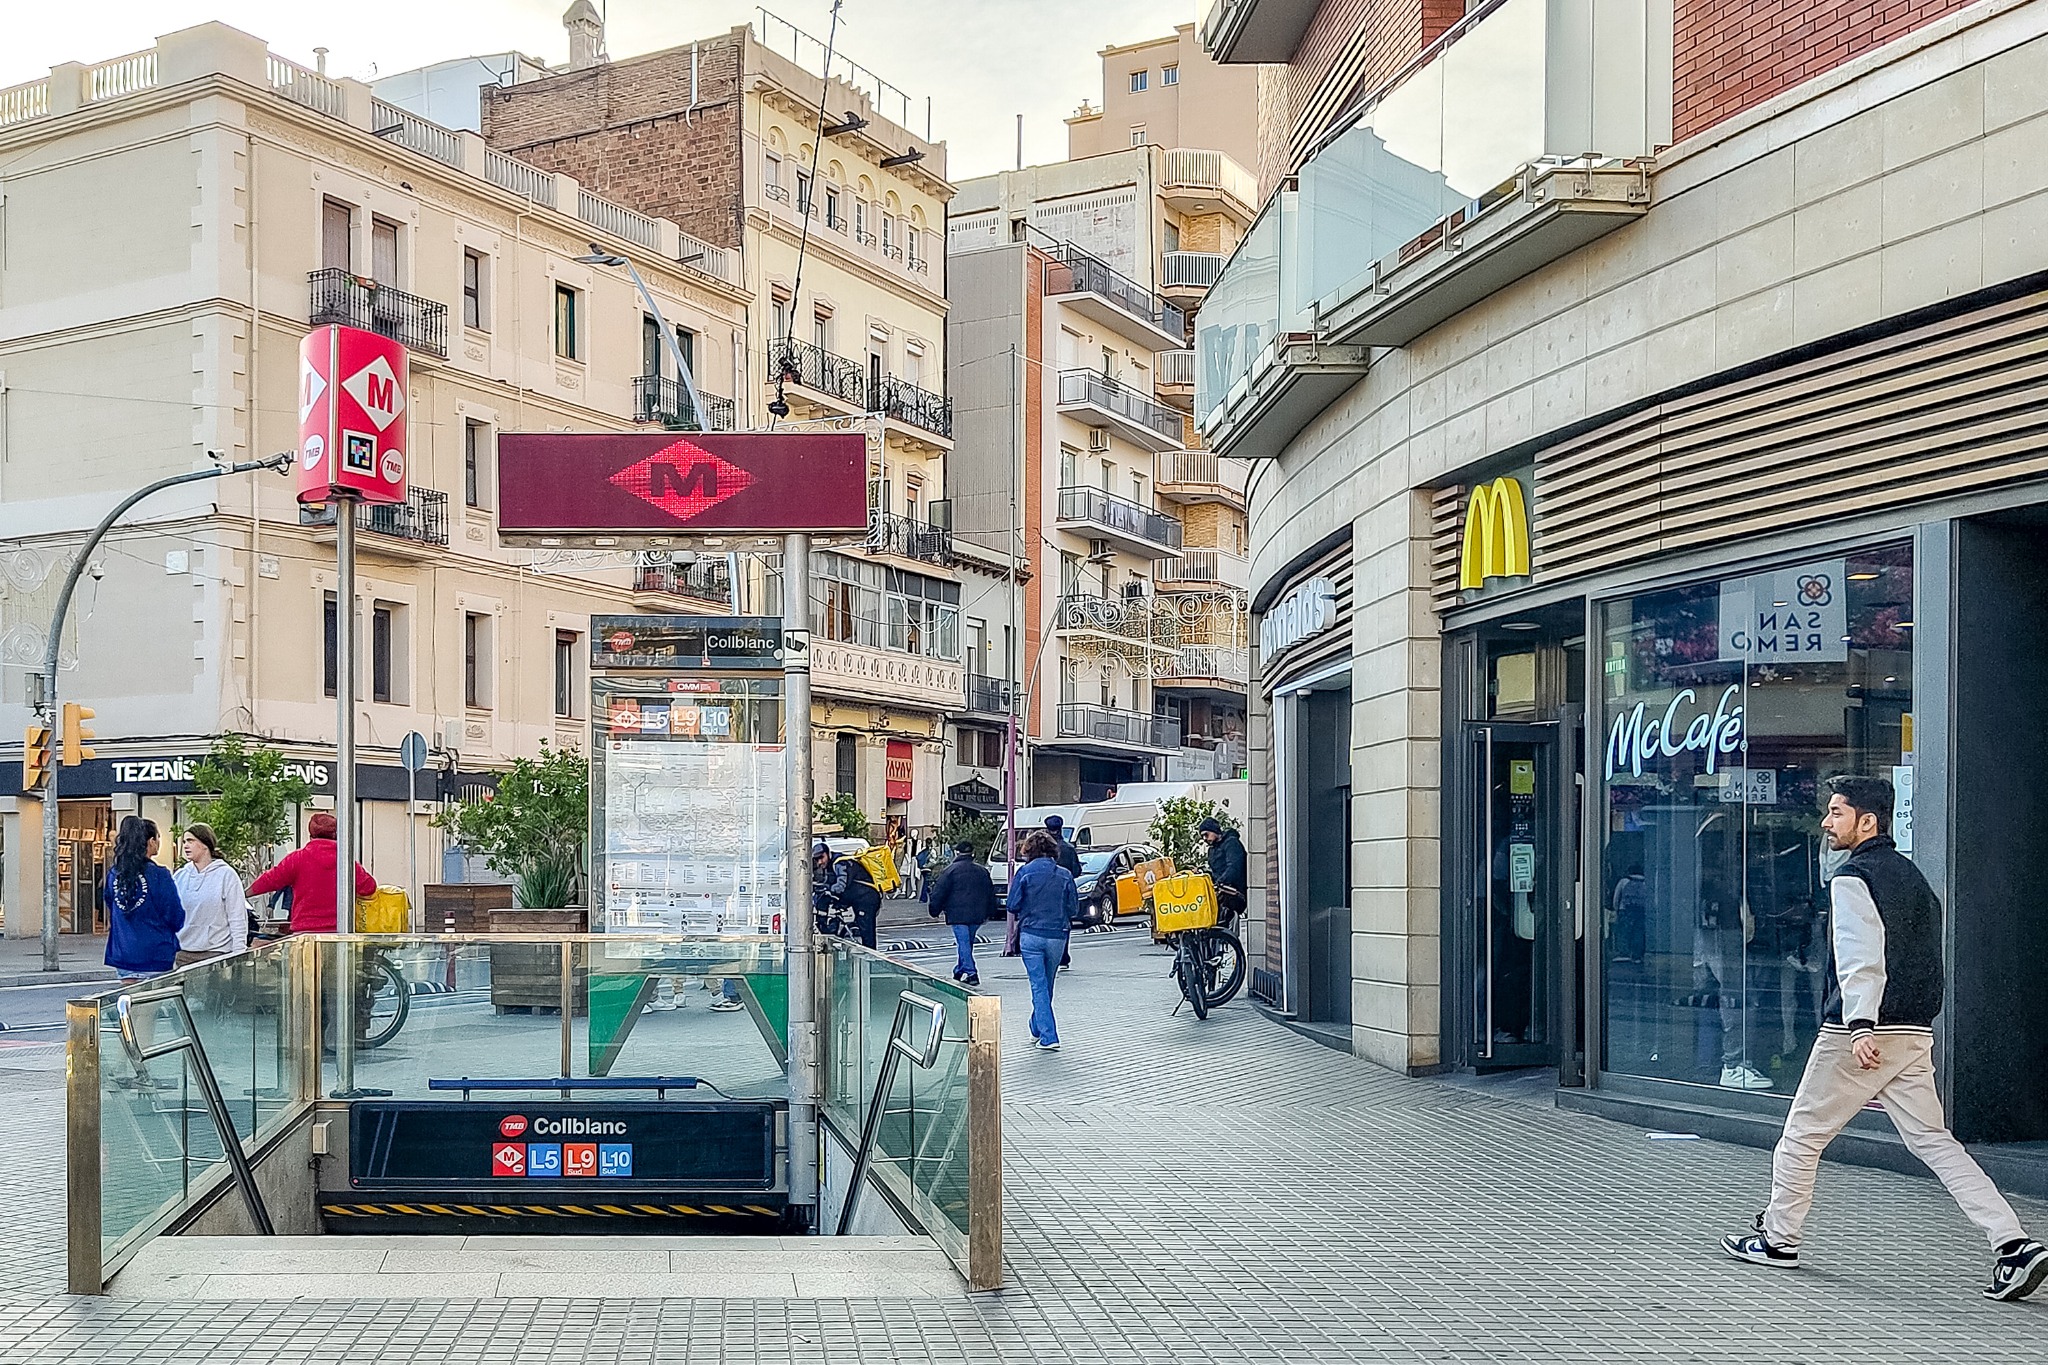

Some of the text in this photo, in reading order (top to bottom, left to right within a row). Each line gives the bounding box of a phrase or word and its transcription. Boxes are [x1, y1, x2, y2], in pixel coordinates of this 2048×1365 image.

[368, 372, 393, 414] M
[305, 446, 320, 460] TMB
[386, 460, 402, 474] TMB
[651, 462, 717, 498] M
[707, 635, 775, 650] Collblanc
[645, 711, 668, 728] L5
[674, 710, 697, 726] L9
[702, 711, 728, 727] L10
[1159, 903, 1198, 914] Glovo
[504, 1117, 627, 1134] TMB Collblanc
[503, 1149, 630, 1169] M L5 L9 L10
[602, 1167, 617, 1175] Sud
